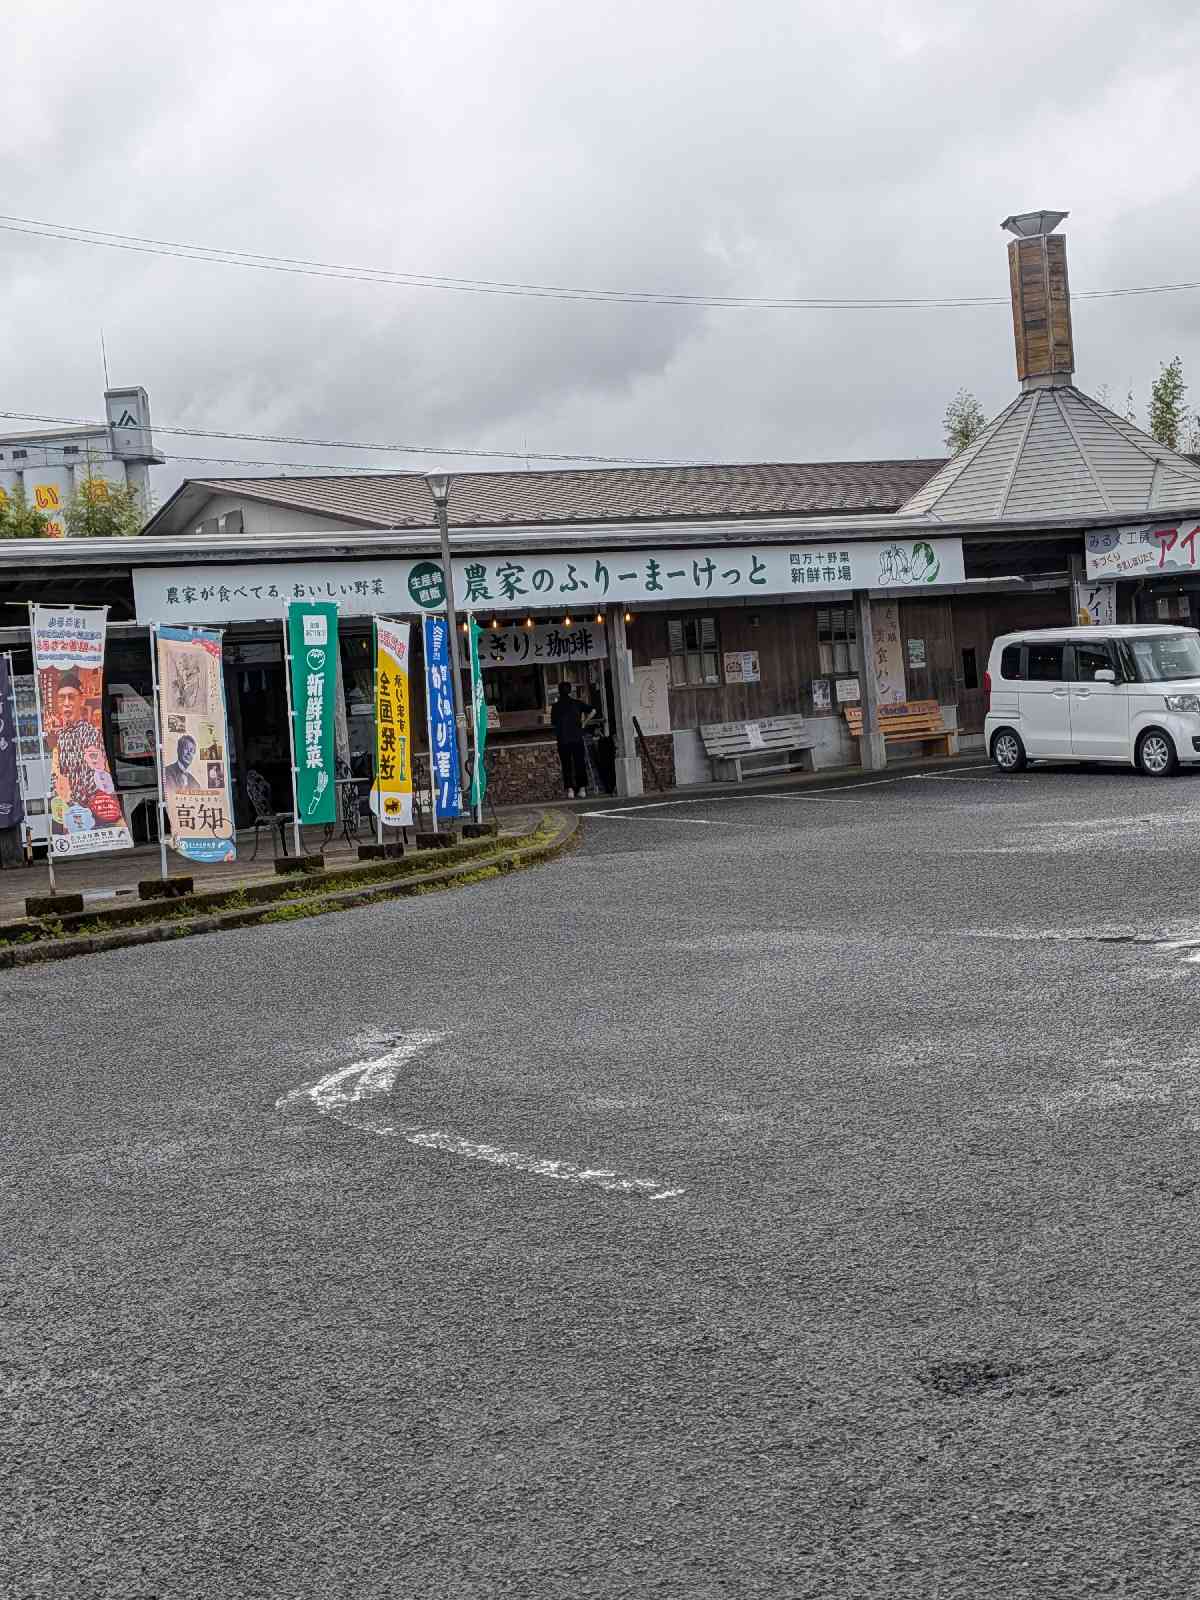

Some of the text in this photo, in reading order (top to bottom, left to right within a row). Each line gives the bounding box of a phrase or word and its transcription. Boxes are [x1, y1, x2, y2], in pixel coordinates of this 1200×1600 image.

[166, 578, 385, 604] 農家が食べてる おいしい野菜
[464, 555, 767, 602] 農家のふりーまーけっと
[791, 566, 851, 584] 新鮮市場
[306, 672, 325, 768] 新鮮野菜
[379, 671, 396, 781] 全国発送
[176, 803, 224, 832] 高知
